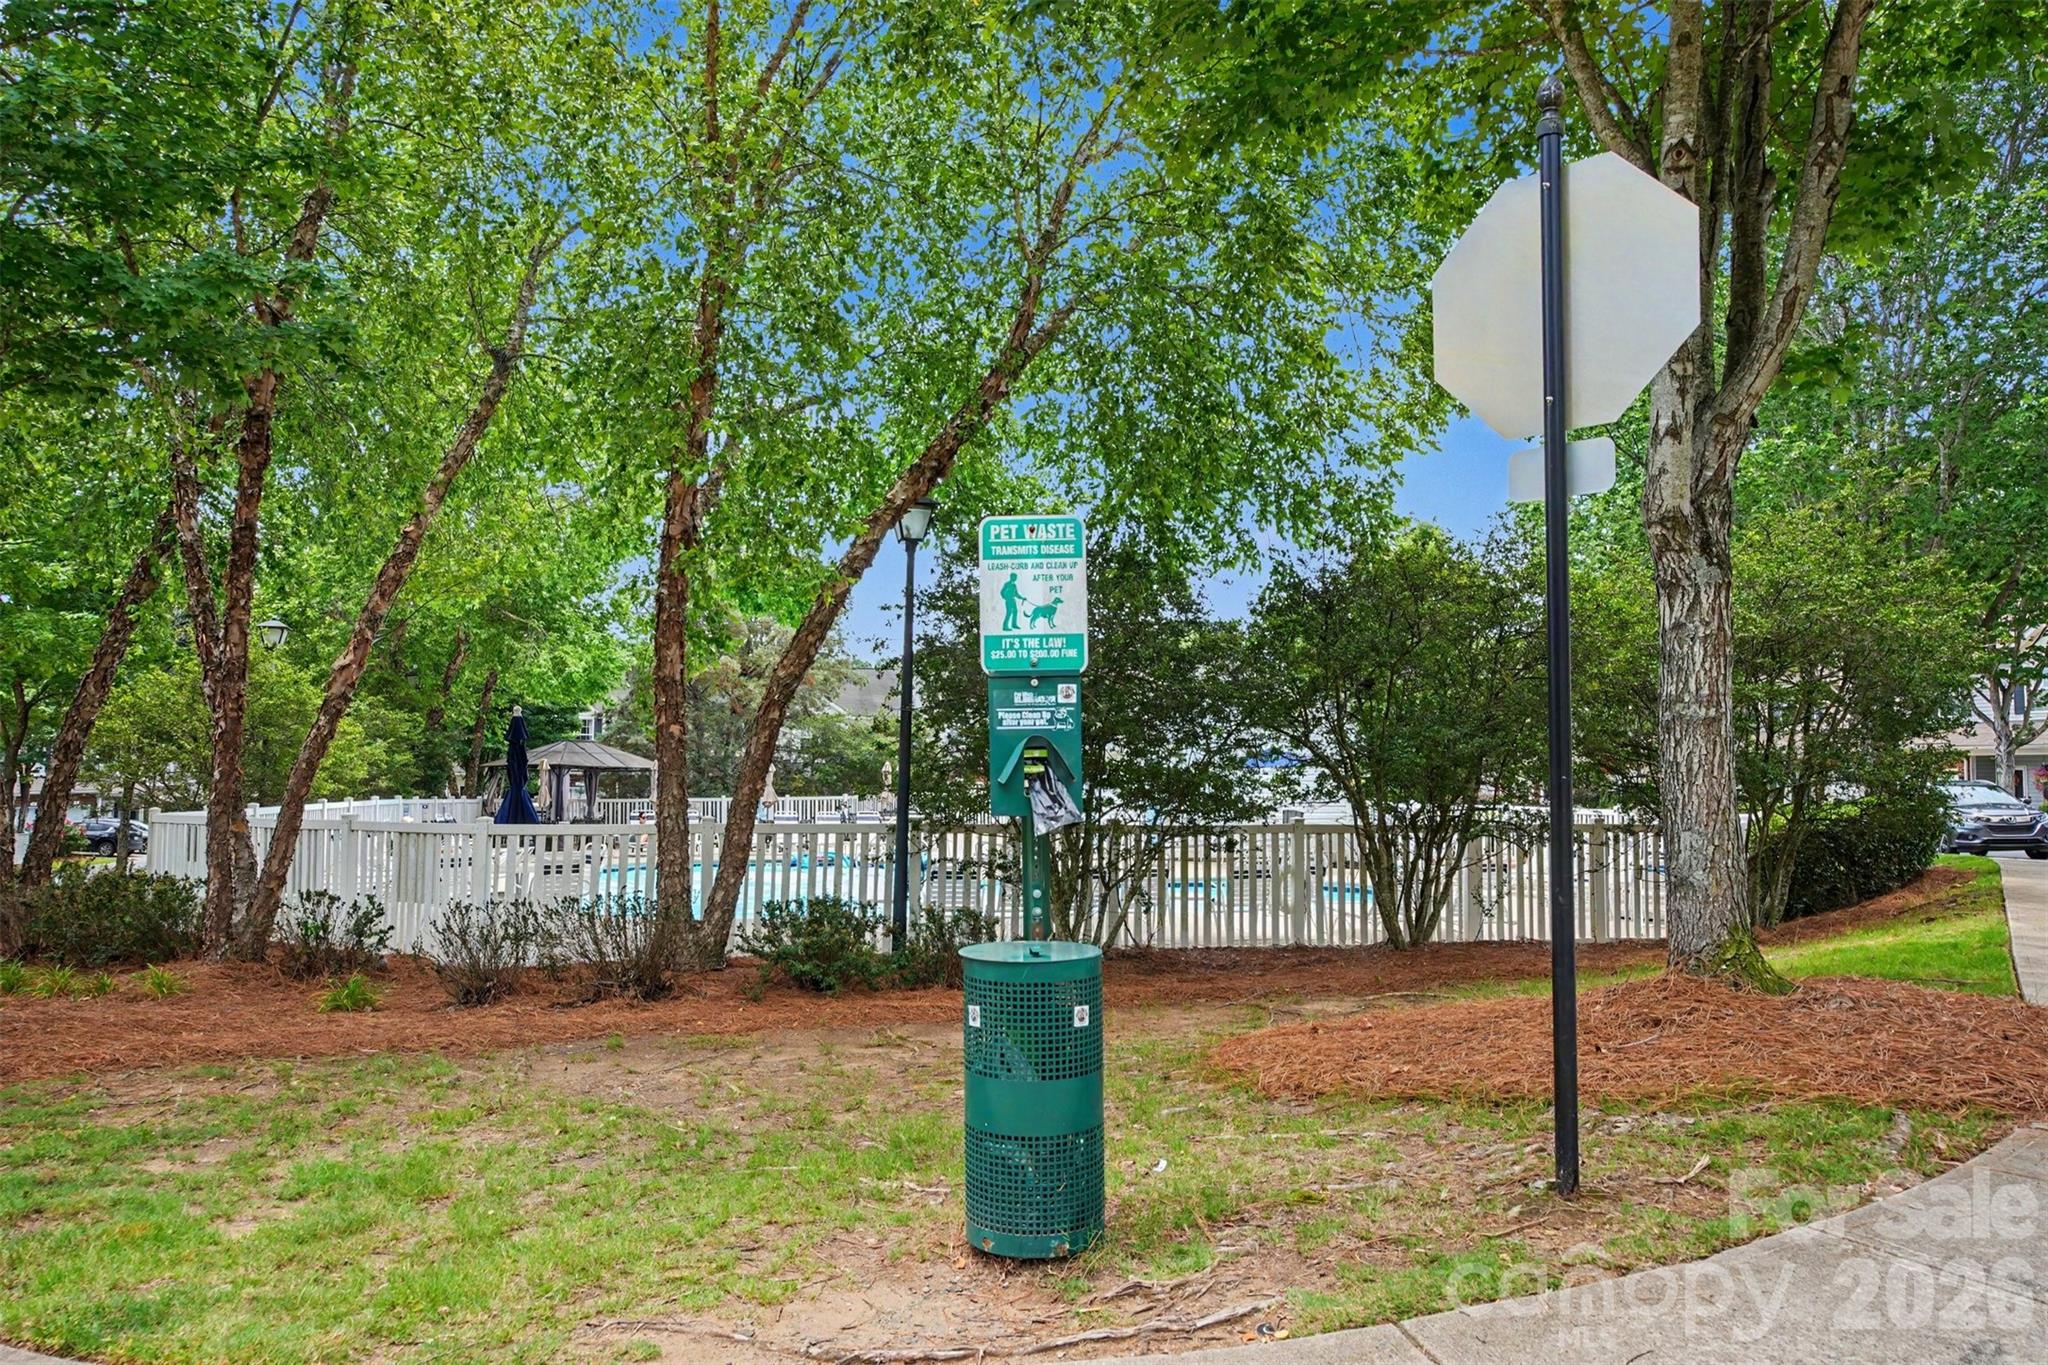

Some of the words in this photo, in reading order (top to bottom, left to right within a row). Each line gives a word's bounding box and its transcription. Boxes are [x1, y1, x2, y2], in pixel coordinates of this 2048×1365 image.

[990, 524, 1018, 539] PET
[1023, 523, 1075, 539] WASTE
[991, 545, 1039, 555] TRANSMITS
[1040, 544, 1075, 554] DISEASE
[1031, 562, 1044, 570] AND
[1046, 561, 1067, 570] CLEAN
[1069, 561, 1079, 569] UP
[1032, 574, 1054, 582] AFTER
[1056, 573, 1074, 581] YOUR
[1001, 638, 1020, 649] IT'S
[1022, 638, 1040, 648] THE
[1042, 637, 1066, 648] LAW!
[990, 650, 1016, 660] $25.00
[1018, 649, 1028, 658] TO
[1061, 648, 1078, 657] FINE
[998, 711, 1021, 720] Please
[1021, 711, 1041, 719] Clean
[1042, 711, 1051, 719] Up
